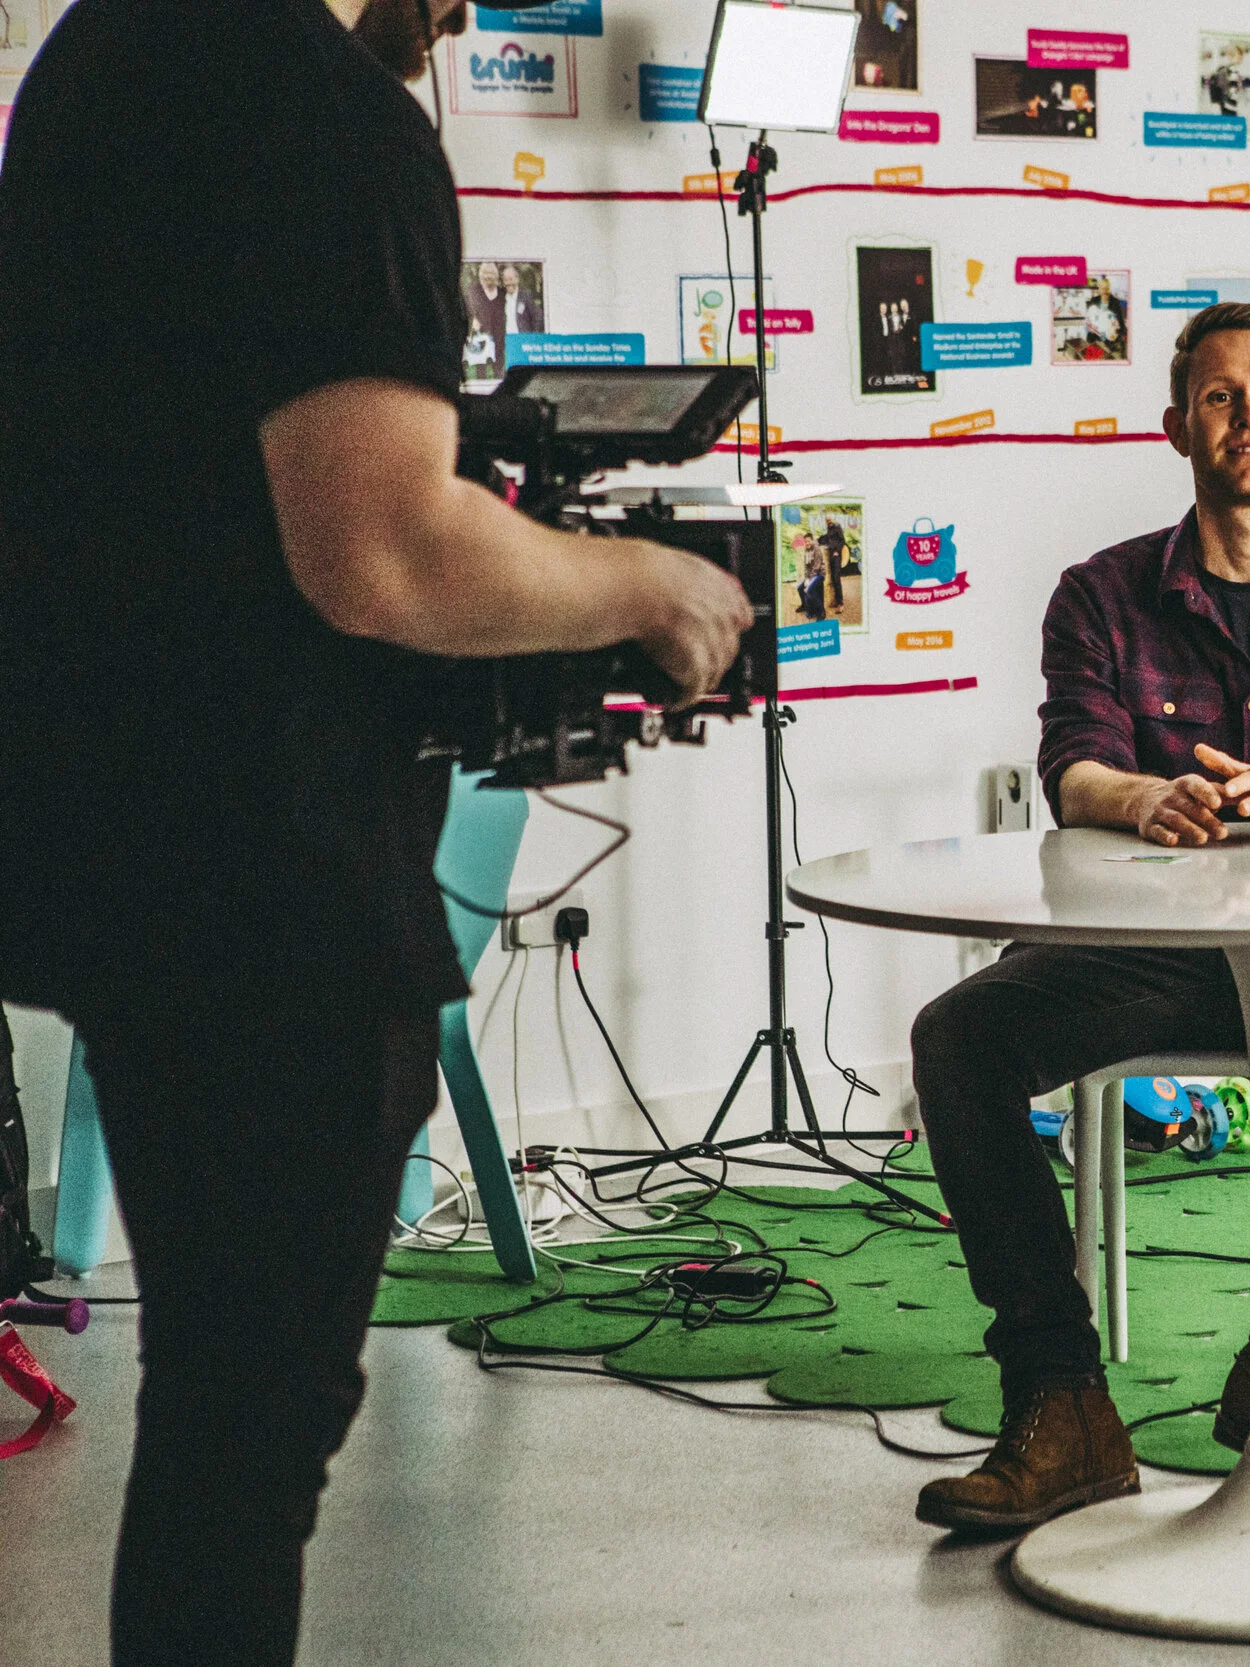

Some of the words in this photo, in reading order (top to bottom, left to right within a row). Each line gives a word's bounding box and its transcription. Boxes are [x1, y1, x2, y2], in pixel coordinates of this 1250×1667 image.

[772, 319, 783, 328] on
[918, 539, 931, 552] 10
[915, 552, 935, 561] YEARS
[894, 590, 905, 601] Of
[906, 590, 932, 602] happy
[933, 585, 960, 599] travels
[907, 636, 924, 648] May
